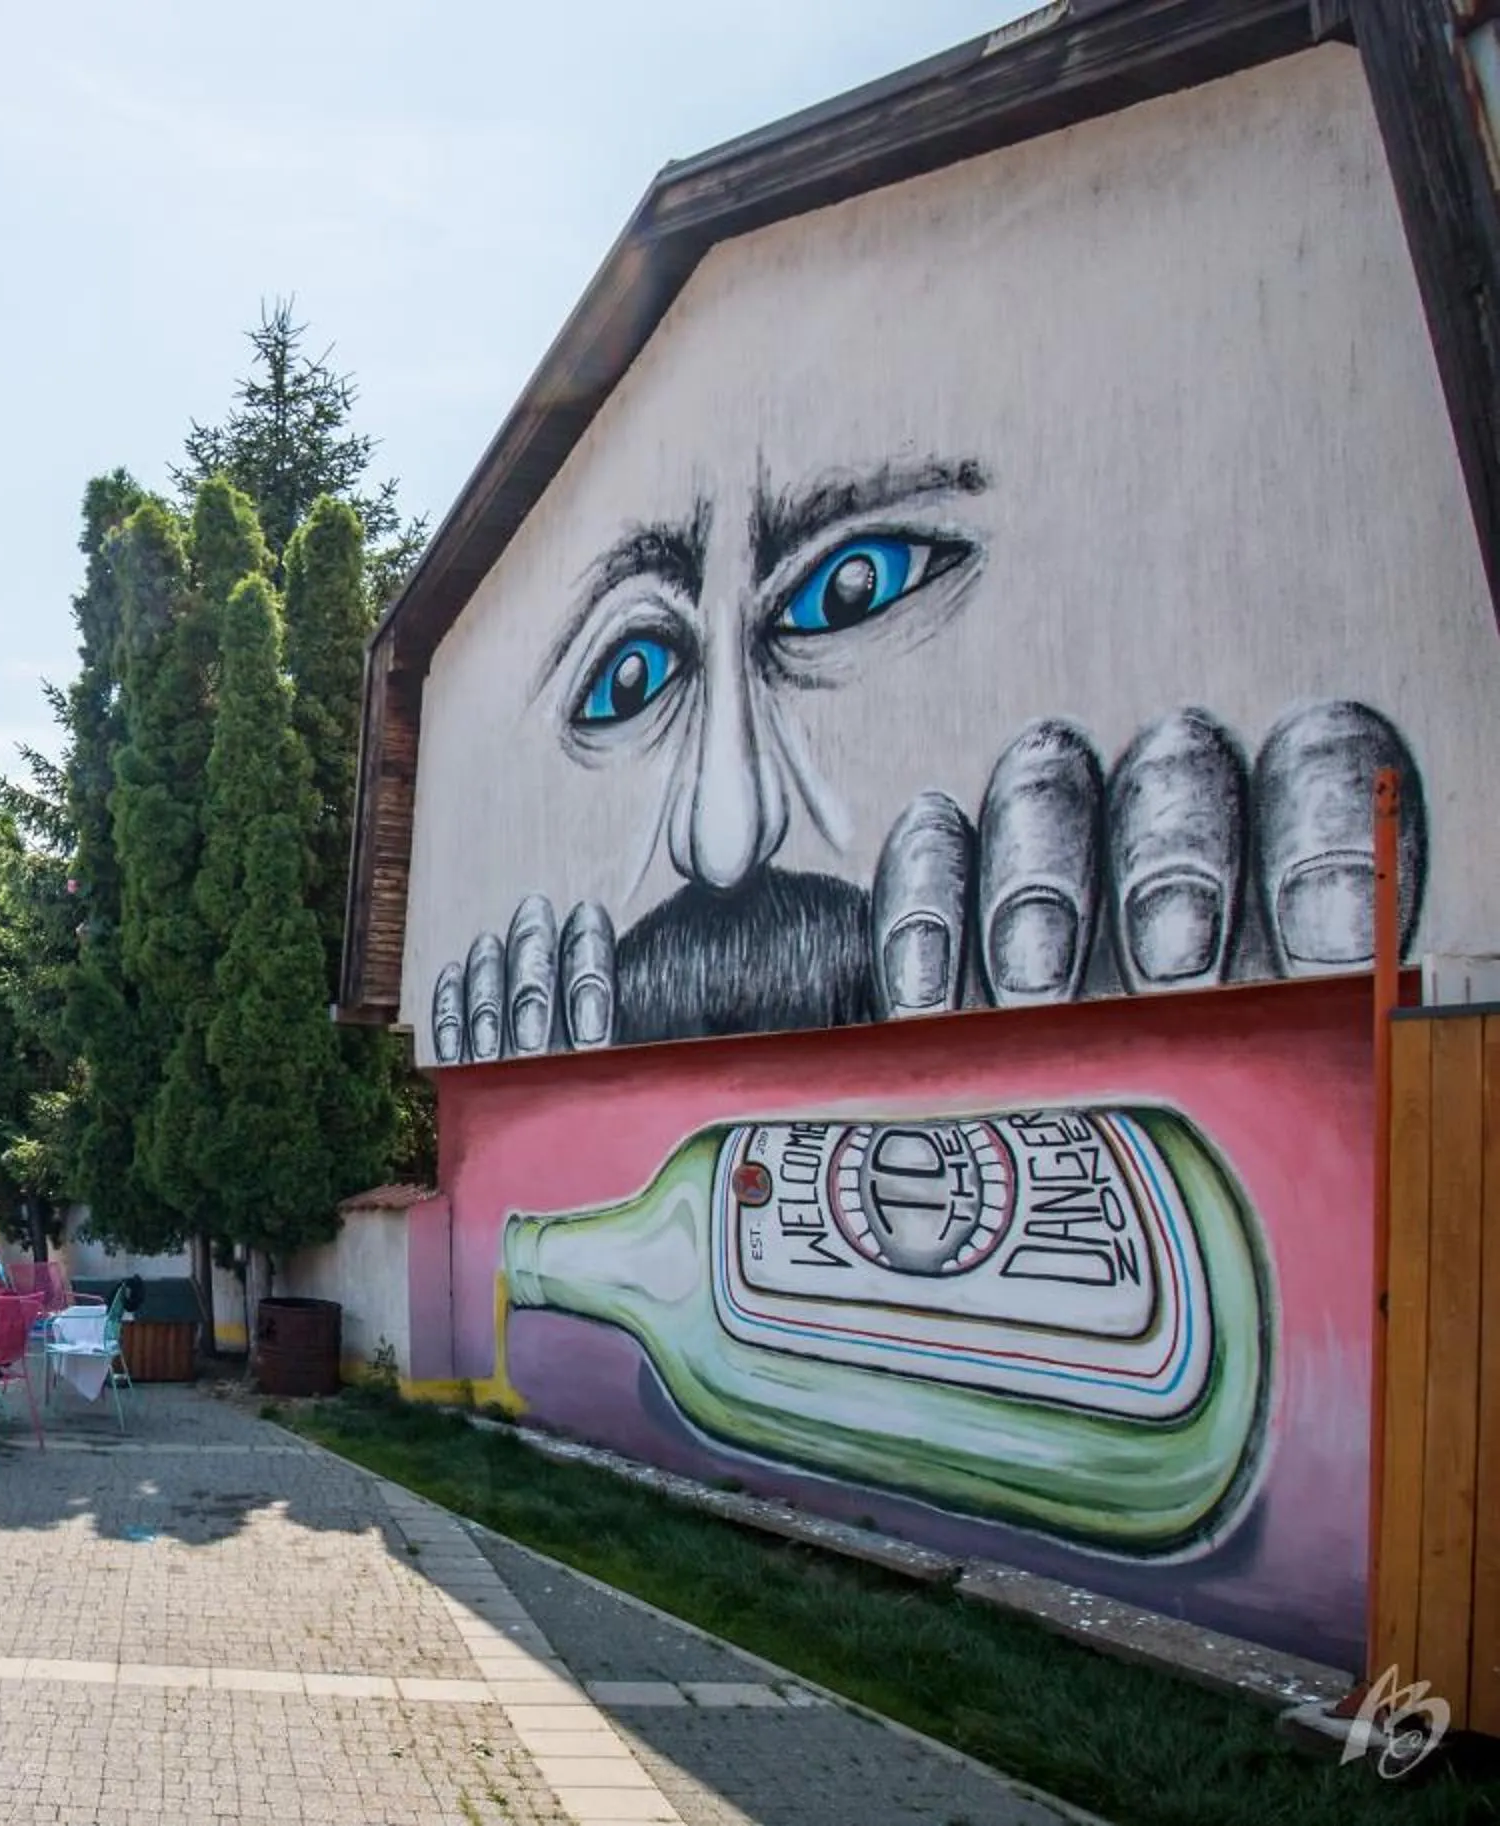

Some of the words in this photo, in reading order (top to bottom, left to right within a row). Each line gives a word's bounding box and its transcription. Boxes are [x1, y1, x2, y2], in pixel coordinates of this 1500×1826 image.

[777, 1122, 853, 1268] WELCOME
[933, 1130, 975, 1241] THE
[999, 1111, 1117, 1287] DANGER
